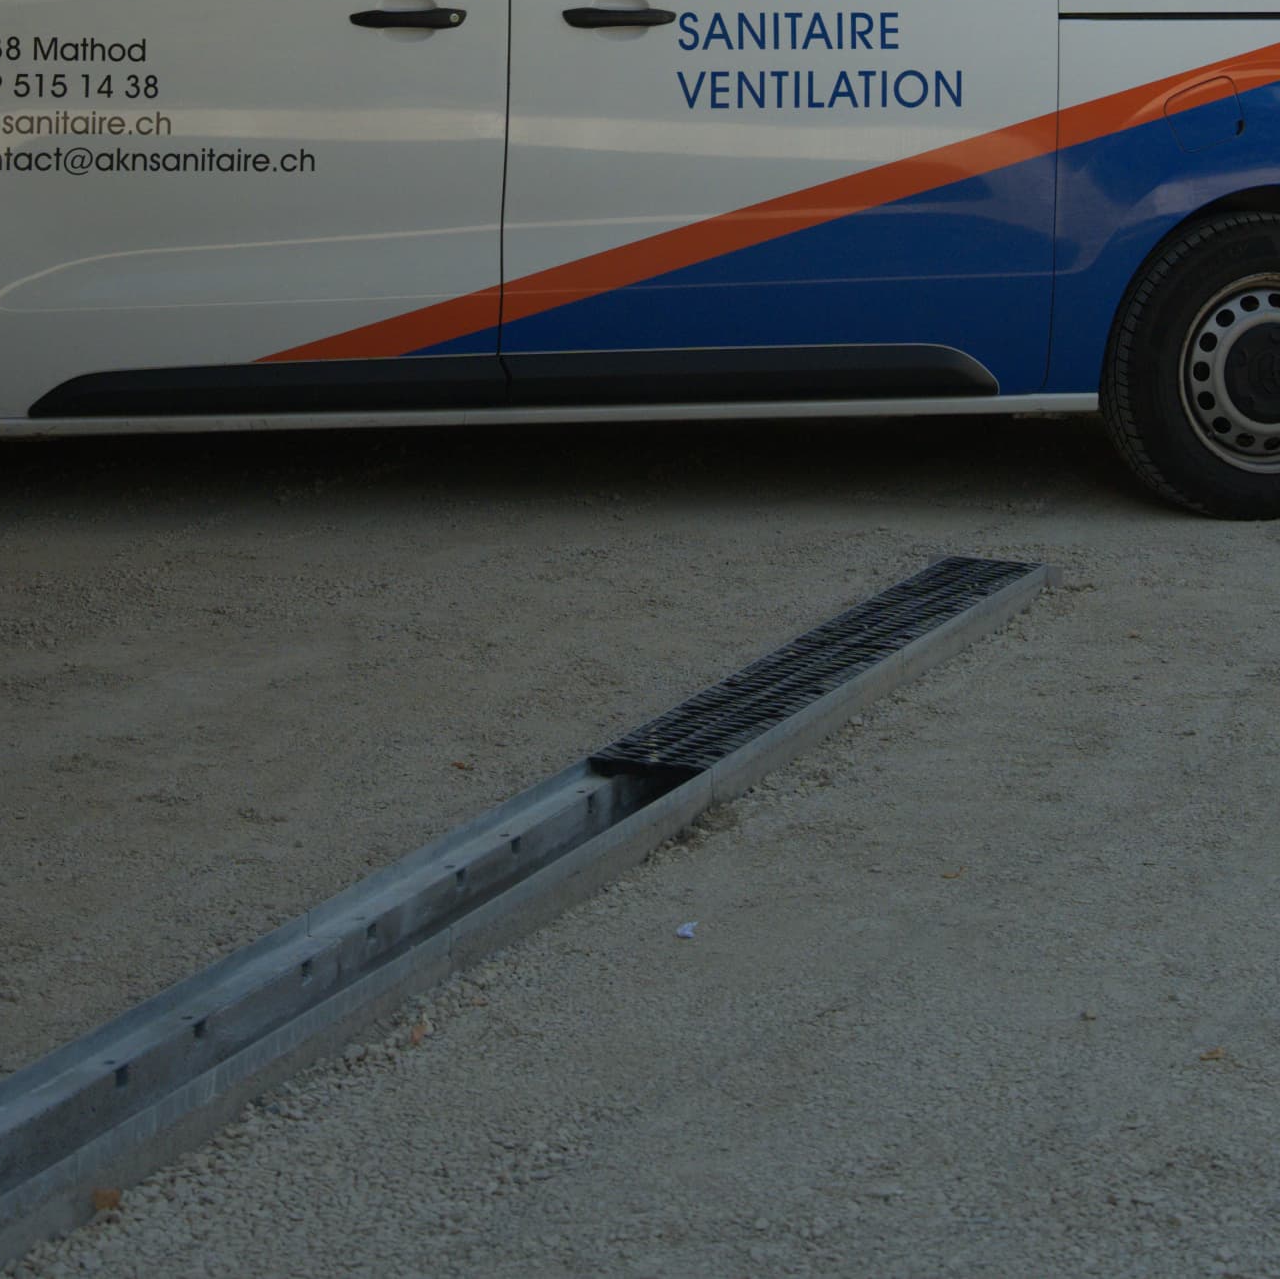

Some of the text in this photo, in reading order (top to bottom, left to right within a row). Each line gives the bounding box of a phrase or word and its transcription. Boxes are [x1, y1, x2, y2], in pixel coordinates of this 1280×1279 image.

[677, 11, 900, 51] SANITAIRE
[32, 36, 147, 63] Mathod
[13, 73, 68, 98] 515
[80, 73, 114, 99] 14
[124, 74, 159, 99] 38
[676, 69, 963, 109] VENTILATION
